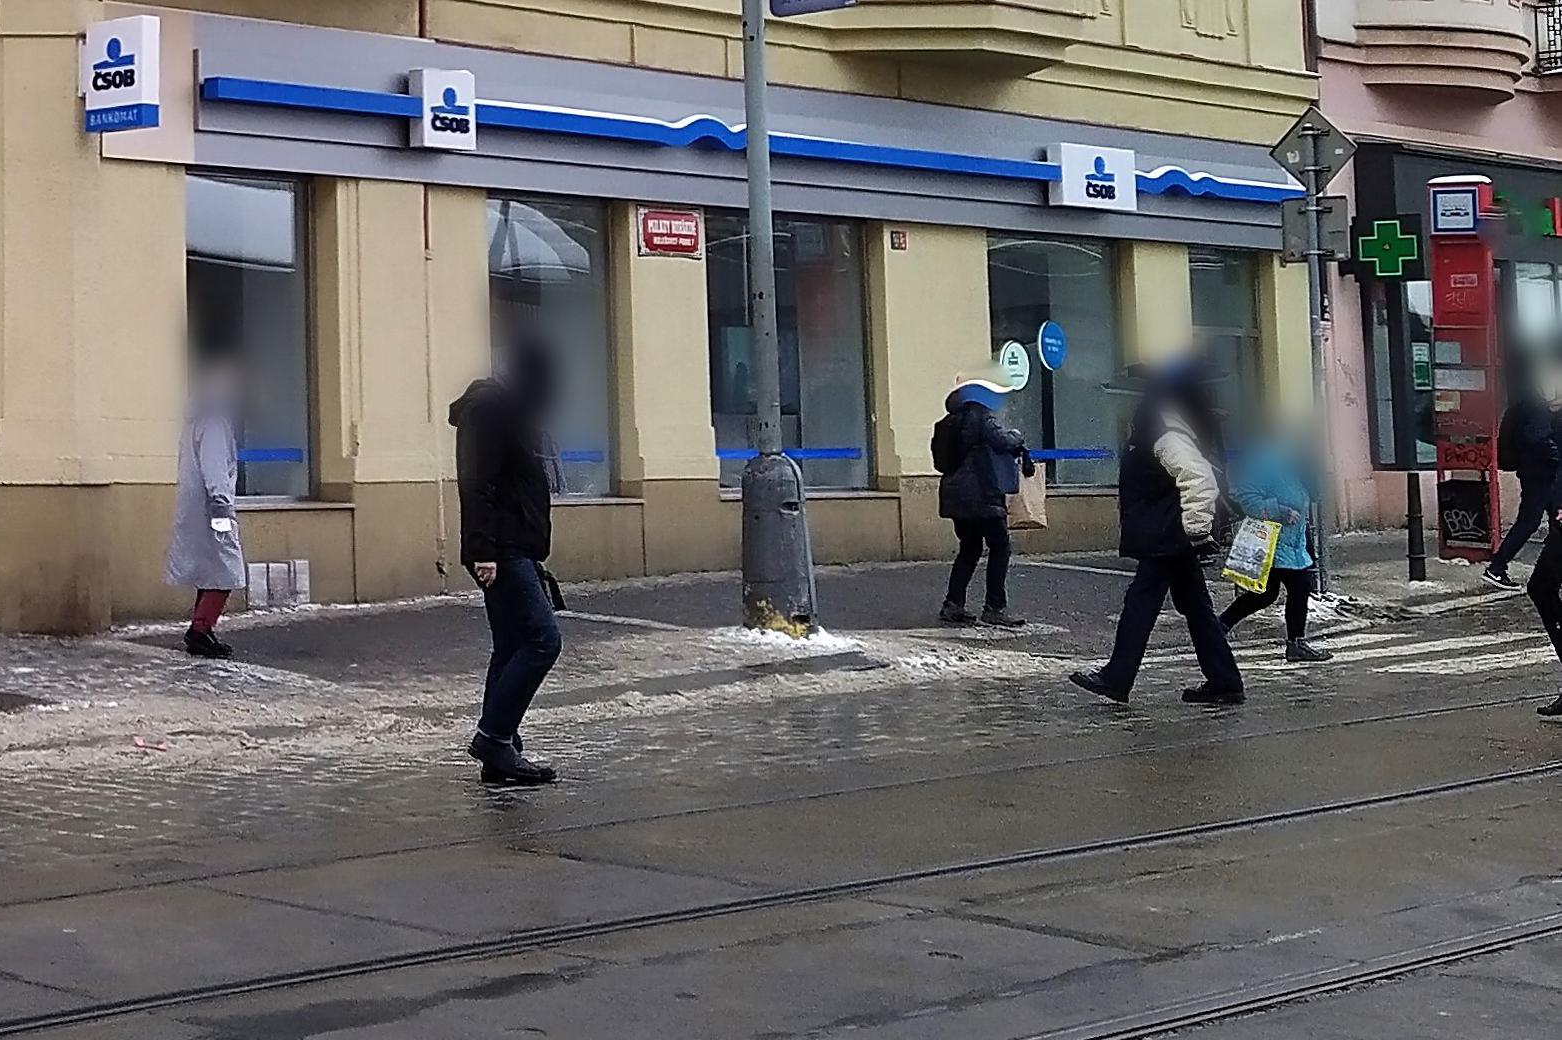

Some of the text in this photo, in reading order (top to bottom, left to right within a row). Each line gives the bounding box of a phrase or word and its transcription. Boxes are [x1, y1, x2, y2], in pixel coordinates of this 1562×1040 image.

[92, 68, 136, 91] ČSOB
[89, 109, 138, 127] BANKOMAT
[430, 112, 470, 134] ČSOB
[1085, 180, 1116, 200] ČSOB
